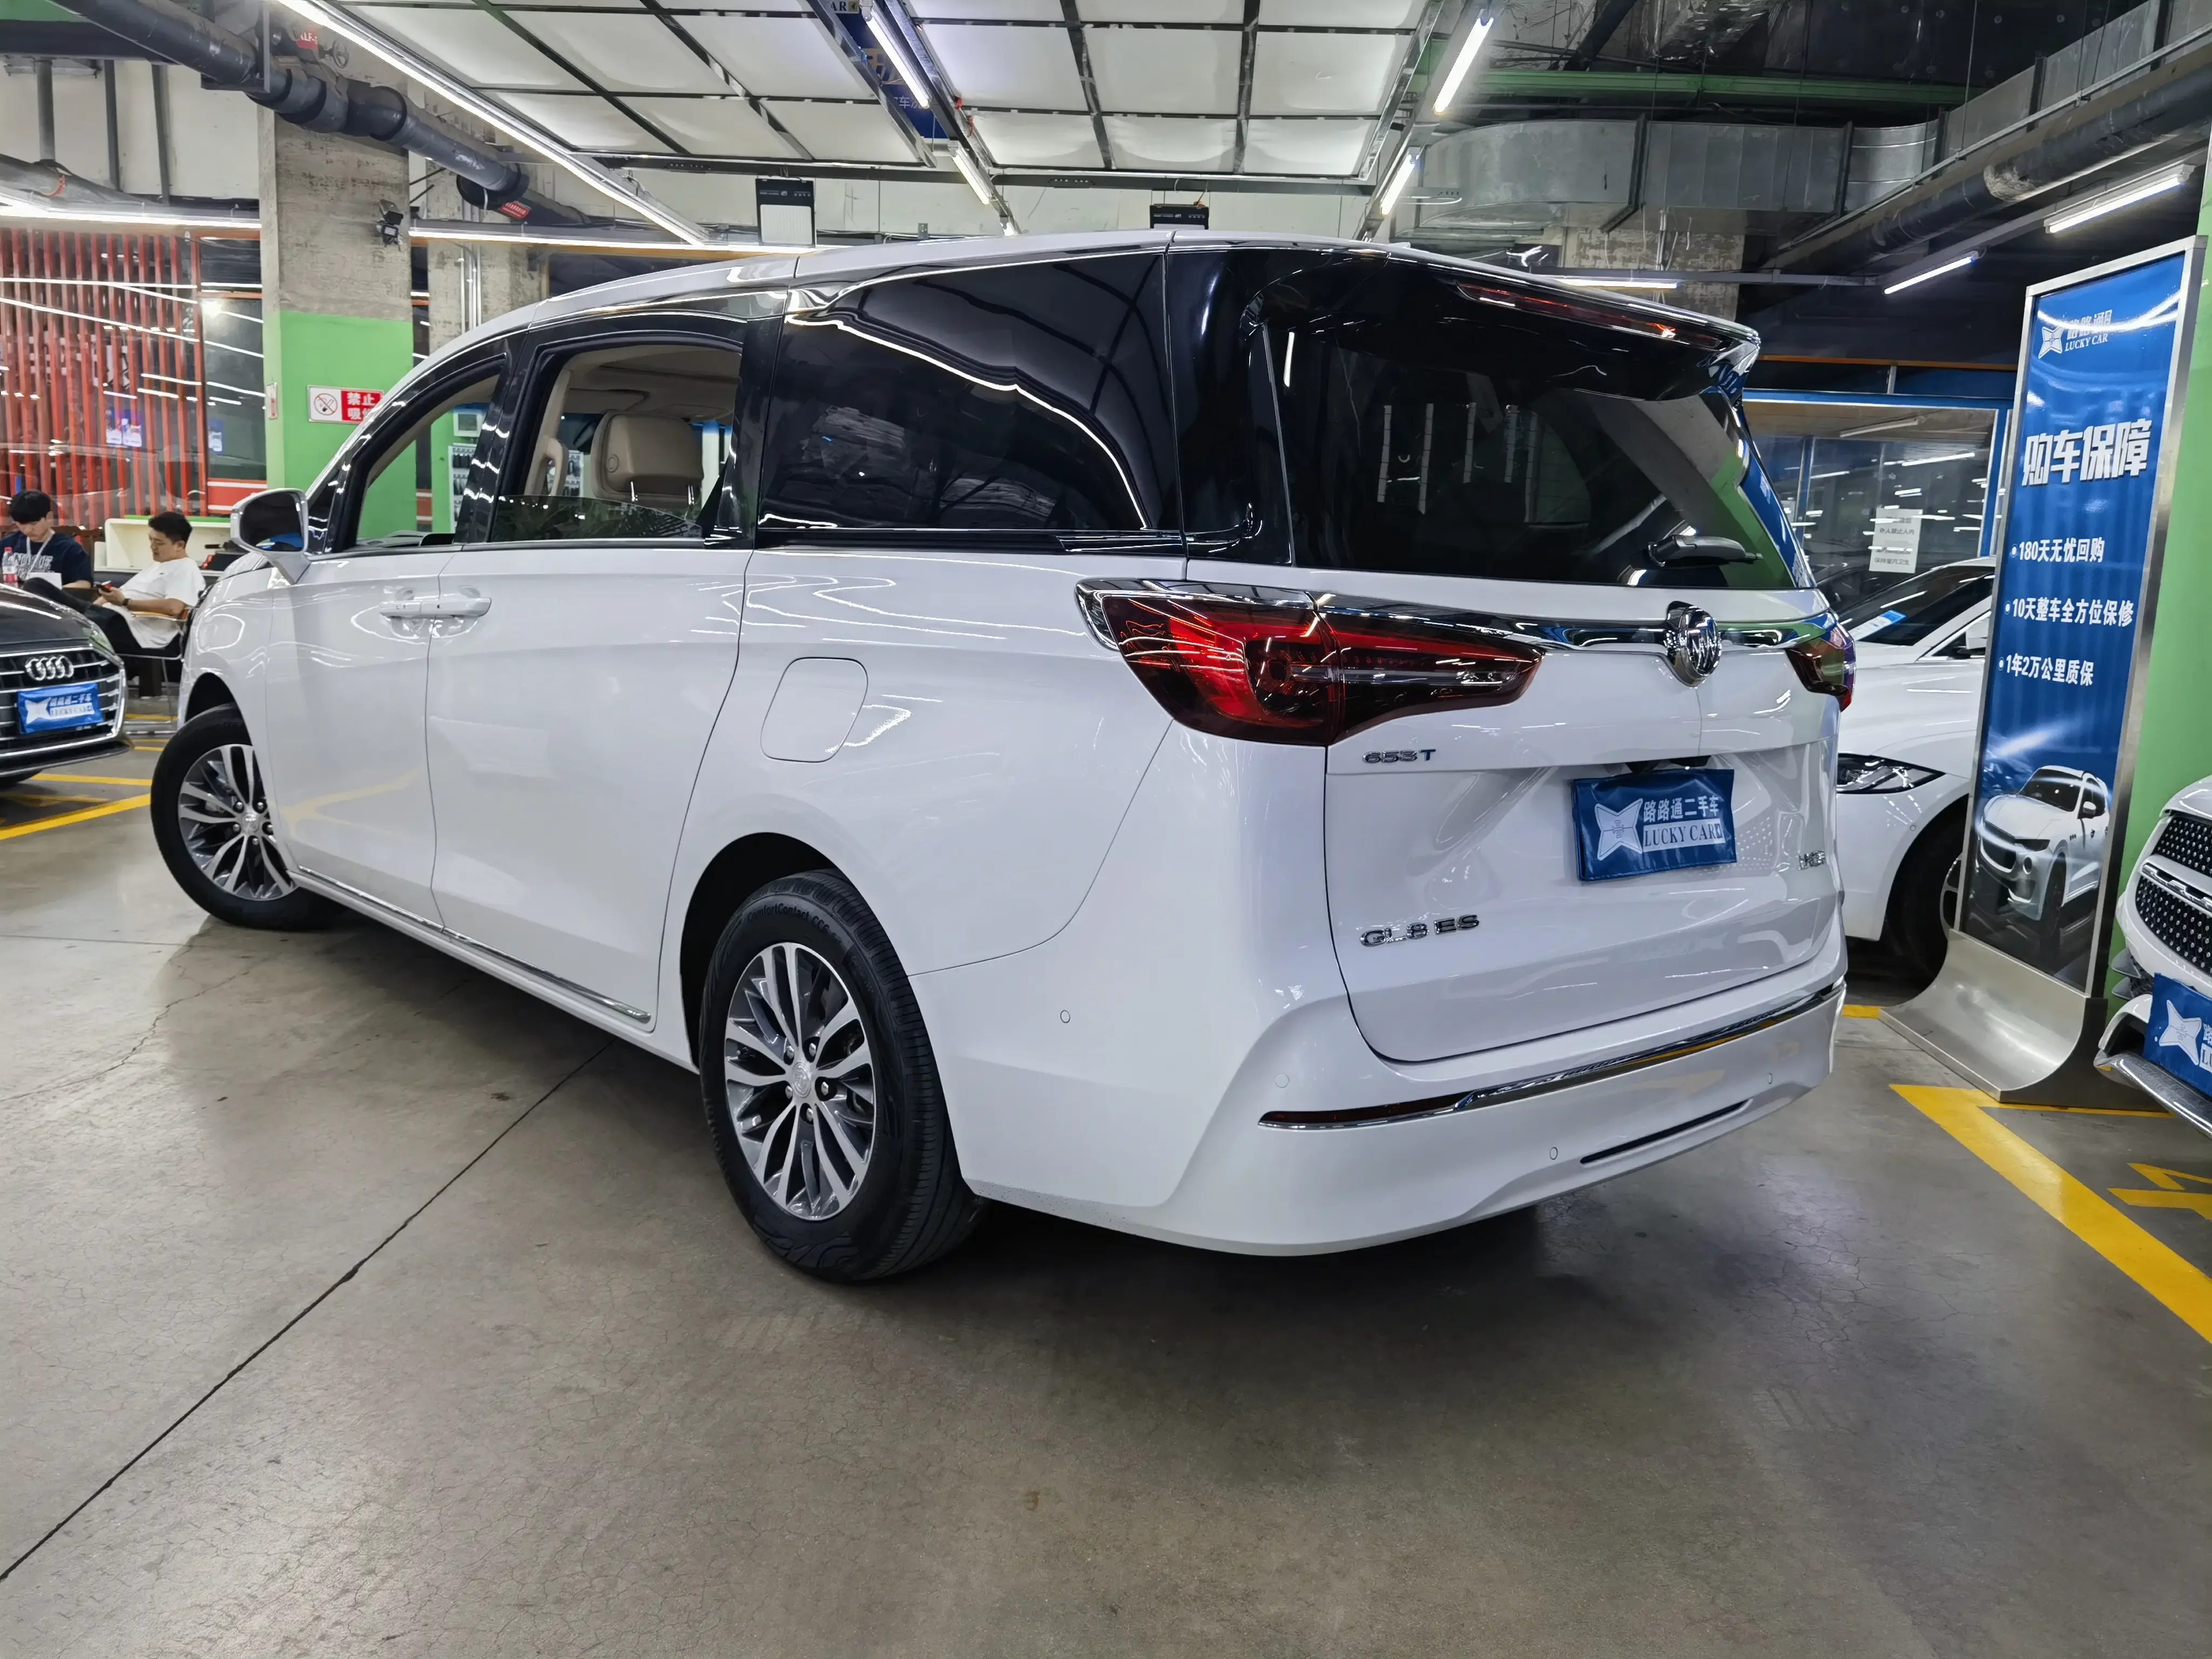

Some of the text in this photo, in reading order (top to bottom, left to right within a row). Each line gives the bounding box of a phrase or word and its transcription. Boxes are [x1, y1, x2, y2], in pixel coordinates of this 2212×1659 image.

[2065, 333, 2108, 352] LUCKY CAR
[347, 392, 376, 406] 禁止
[2021, 418, 2153, 486] 购车保障
[2019, 537, 2105, 563] 180天无忧回购
[2012, 597, 2134, 627] 10天整车全方位保修
[2006, 653, 2094, 686] 1年2万公里质保
[1643, 795, 1719, 822] 路路通二手车
[1644, 826, 1685, 847] LUCKY
[1359, 914, 1480, 947] GL8 ES
